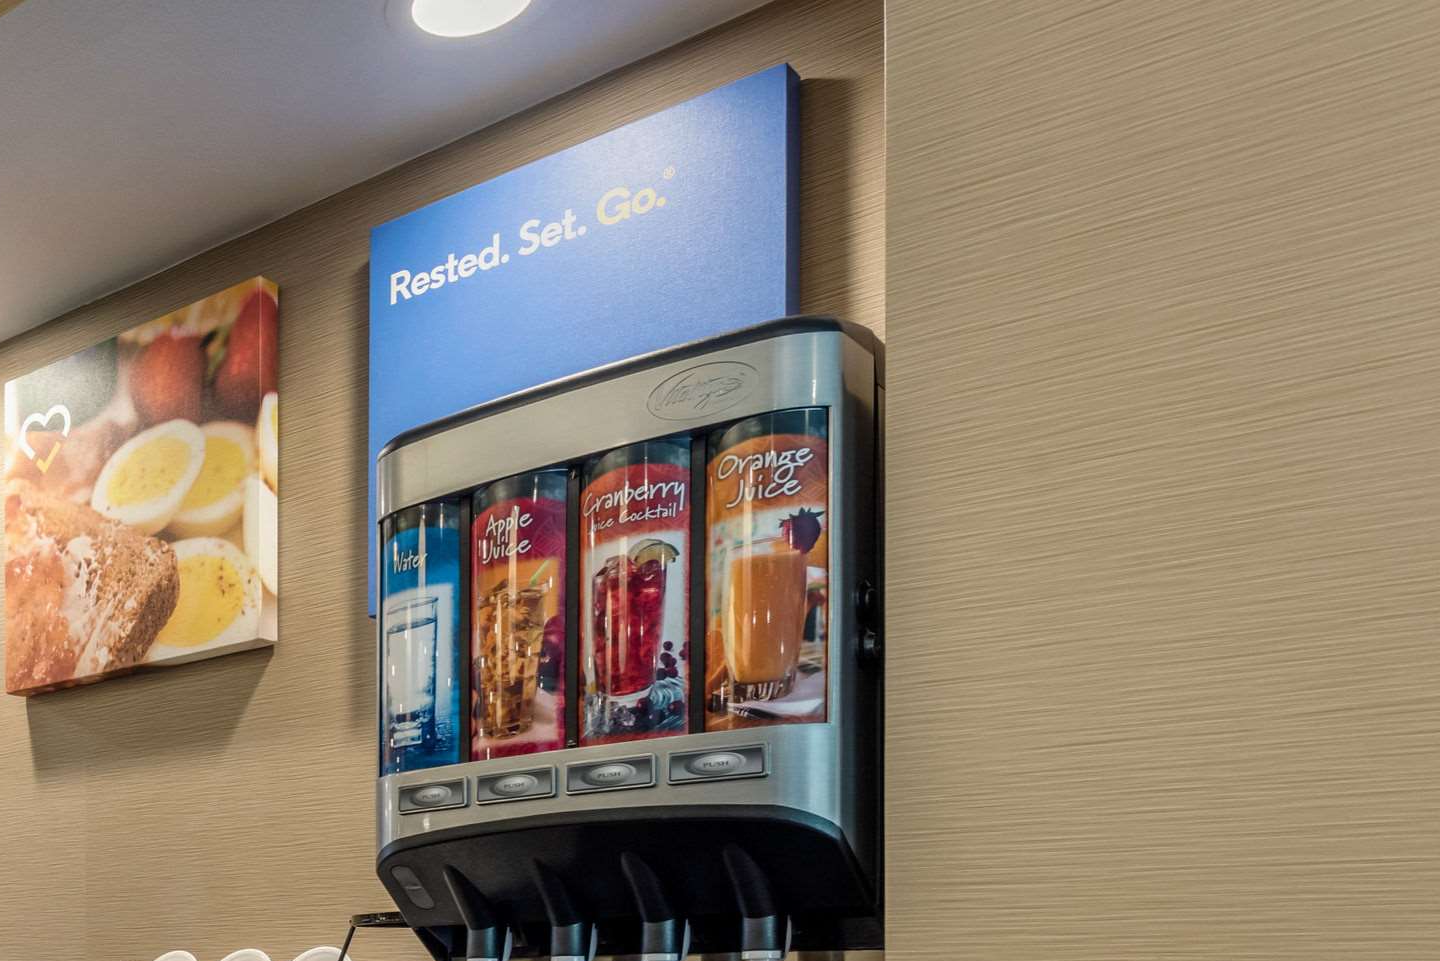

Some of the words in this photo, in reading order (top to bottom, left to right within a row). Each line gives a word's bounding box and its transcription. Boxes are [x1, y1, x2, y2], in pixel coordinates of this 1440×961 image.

[389, 232, 511, 306] Rested.
[518, 208, 589, 257] Set.
[718, 447, 814, 484] Orange
[583, 480, 686, 517] Cranberry
[726, 475, 802, 508] Juice
[485, 507, 534, 545] Apple
[619, 503, 678, 524] Cocktail
[393, 550, 429, 574] Water
[482, 537, 532, 564] Juice
[596, 771, 621, 779] PUSH
[702, 760, 729, 768] PUSH
